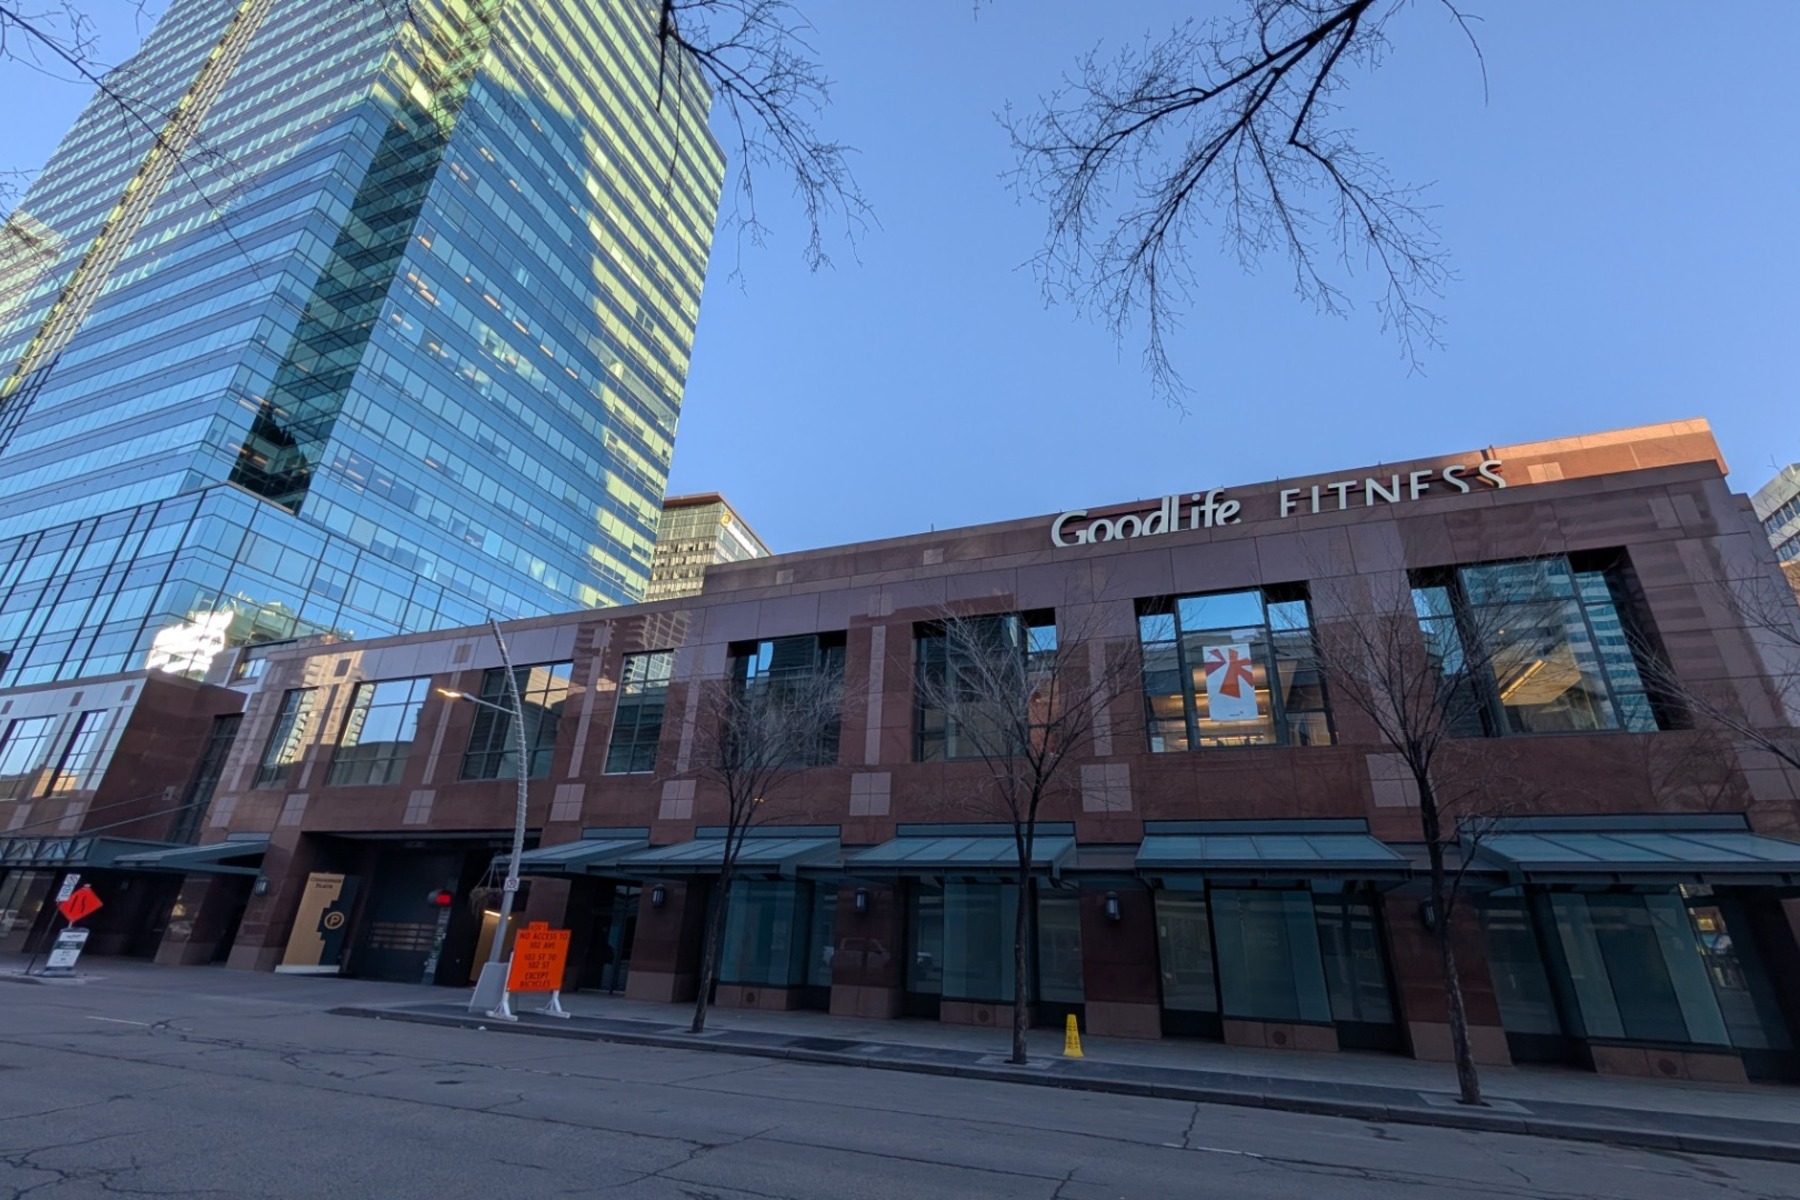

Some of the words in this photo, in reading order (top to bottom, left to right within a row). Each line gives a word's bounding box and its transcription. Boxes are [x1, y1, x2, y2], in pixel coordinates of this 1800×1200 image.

[520, 932, 531, 940] NO
[533, 932, 557, 940] ACCESS
[560, 932, 568, 941] TO
[549, 953, 557, 961] TO
[524, 971, 549, 979] EXCEPT
[519, 980, 551, 988] BICYCLES
